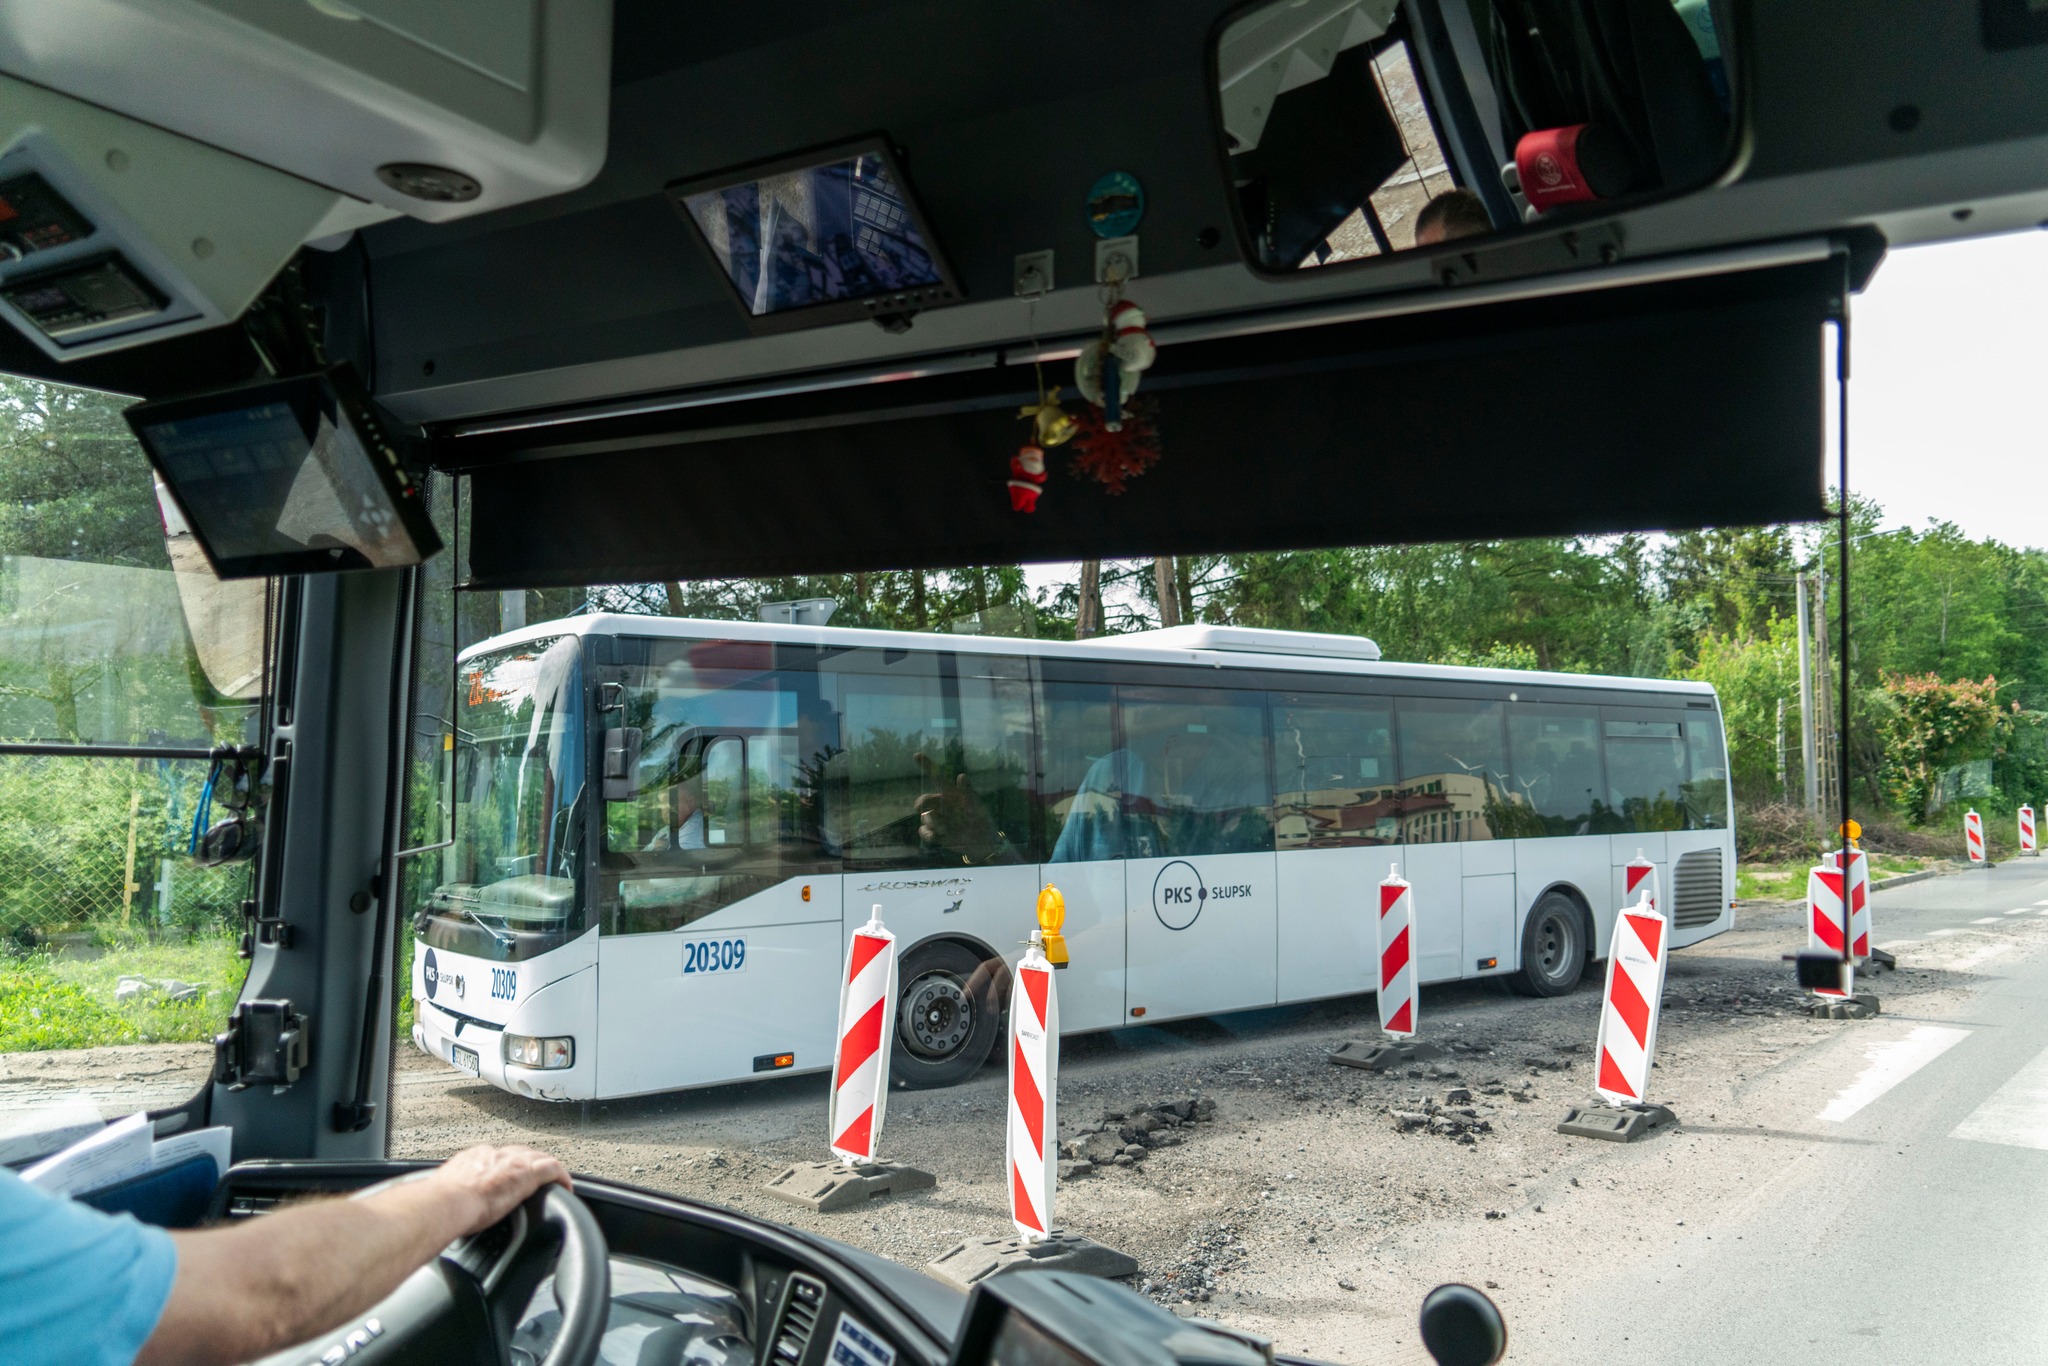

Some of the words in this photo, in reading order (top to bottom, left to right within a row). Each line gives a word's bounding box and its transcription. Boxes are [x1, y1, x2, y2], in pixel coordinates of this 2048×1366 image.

[1164, 886, 1193, 905] PKS
[1212, 884, 1252, 900] SŁUPSK
[684, 939, 746, 973] 20309
[425, 965, 436, 982] PKS
[491, 967, 517, 1001] 20309
